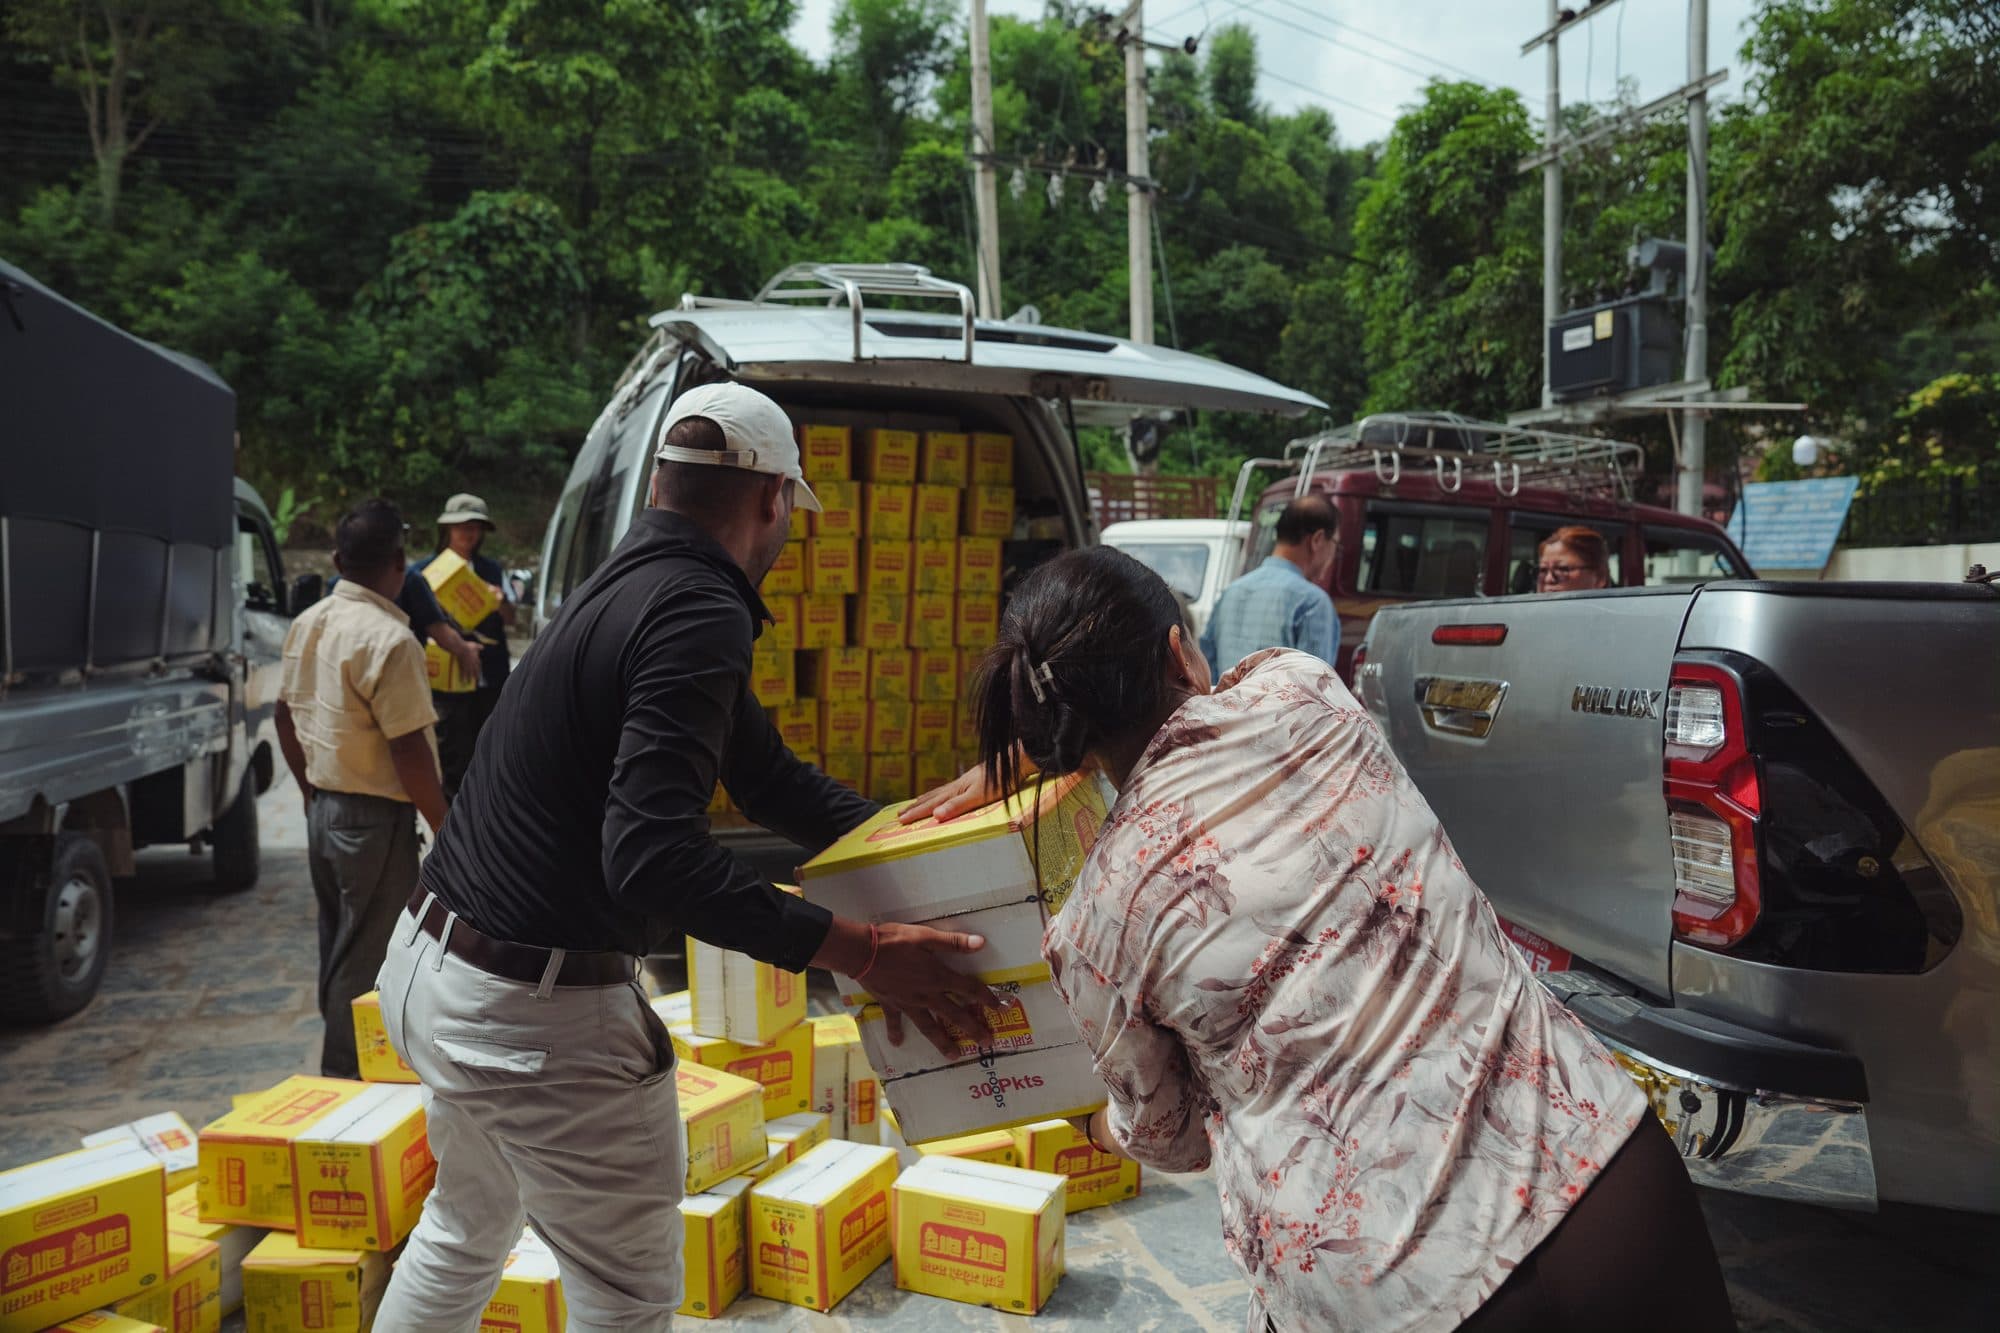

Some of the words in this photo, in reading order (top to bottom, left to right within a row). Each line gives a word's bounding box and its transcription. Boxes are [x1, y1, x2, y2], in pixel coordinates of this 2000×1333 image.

[1571, 684, 1661, 720] HILUX
[969, 1083, 993, 1100] 30
[999, 1075, 1045, 1095] Pkts
[986, 1071, 1006, 1109] FOODS
